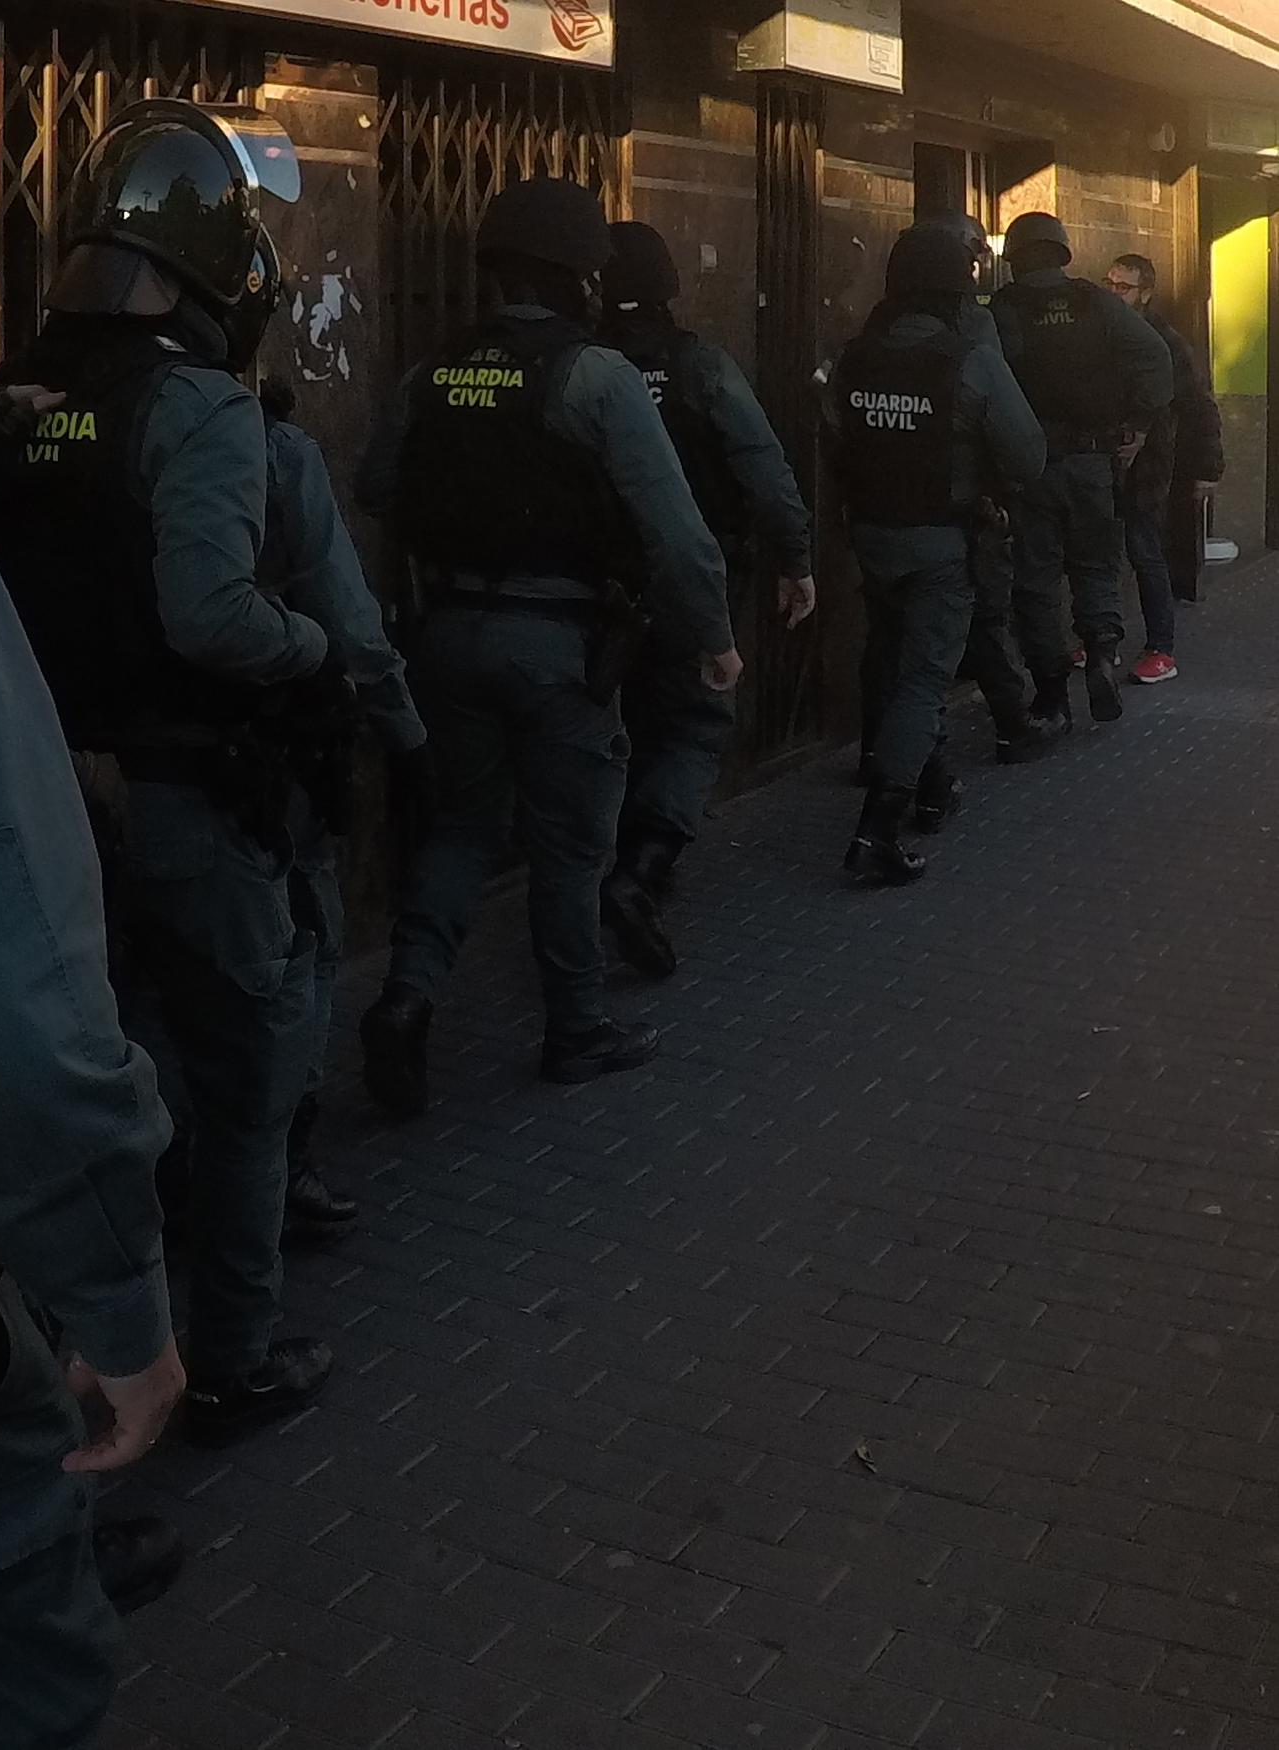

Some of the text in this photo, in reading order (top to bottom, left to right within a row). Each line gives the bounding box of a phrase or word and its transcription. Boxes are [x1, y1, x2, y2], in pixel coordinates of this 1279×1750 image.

[432, 367, 524, 388] GUARDIA
[643, 370, 670, 382] IVIL
[447, 387, 497, 408] CIVIL
[849, 390, 934, 415] GUARDIA
[35, 410, 98, 441] RDIA
[865, 410, 917, 430] CIVIL
